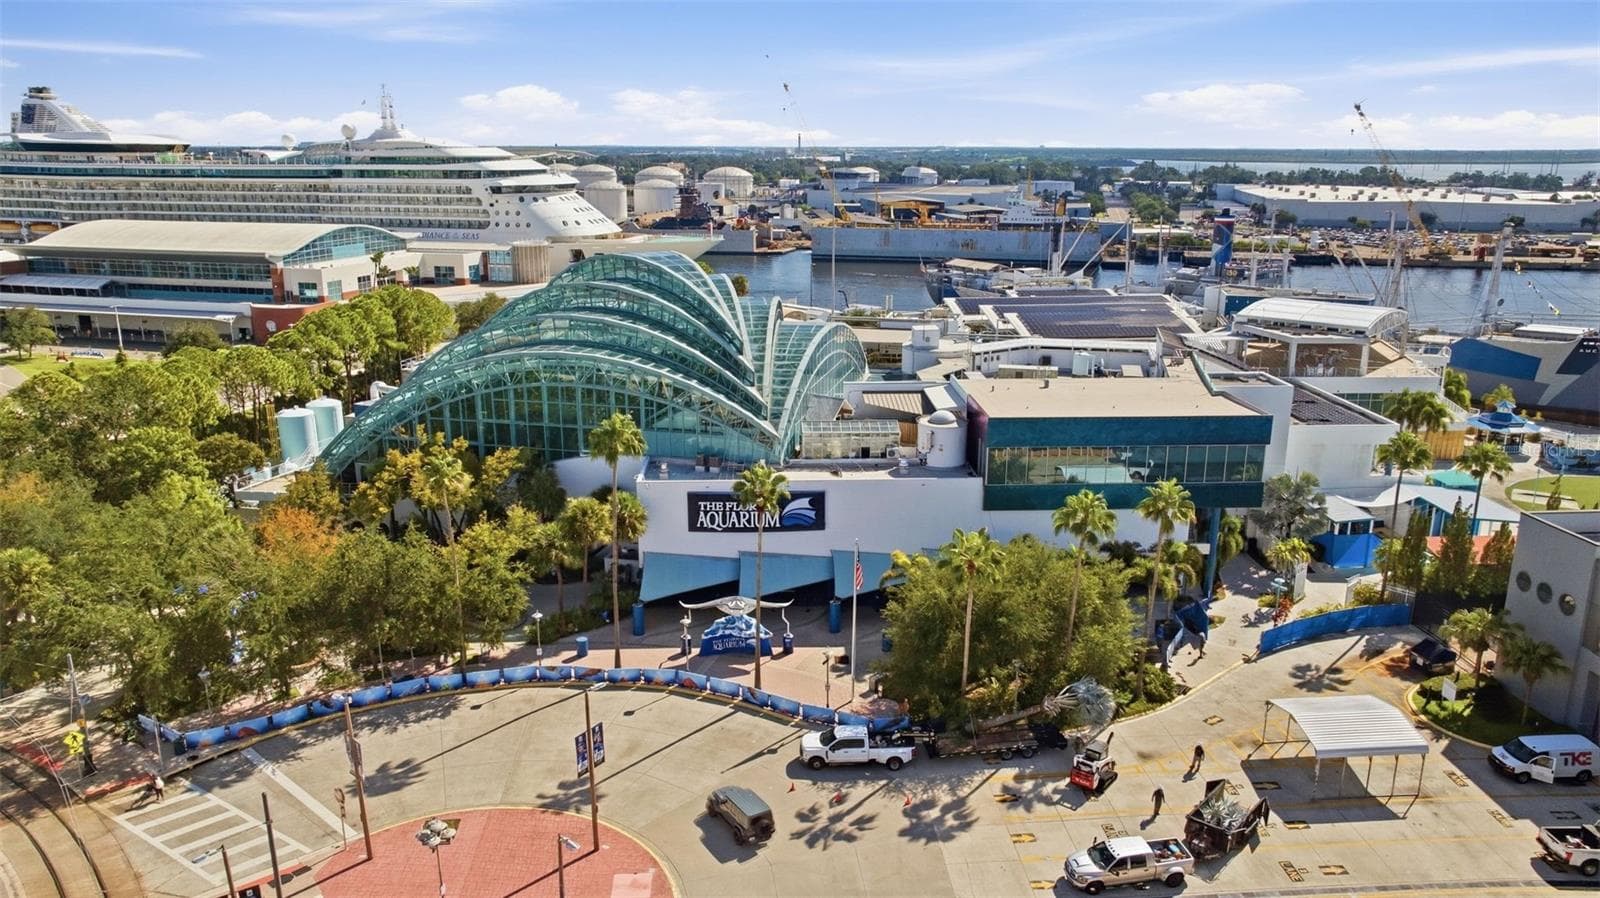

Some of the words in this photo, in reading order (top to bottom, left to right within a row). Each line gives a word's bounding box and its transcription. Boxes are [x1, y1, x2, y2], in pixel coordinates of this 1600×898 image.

[698, 502, 724, 511] THE
[697, 511, 781, 531] AQUARIUM
[1560, 752, 1592, 767] TKE
